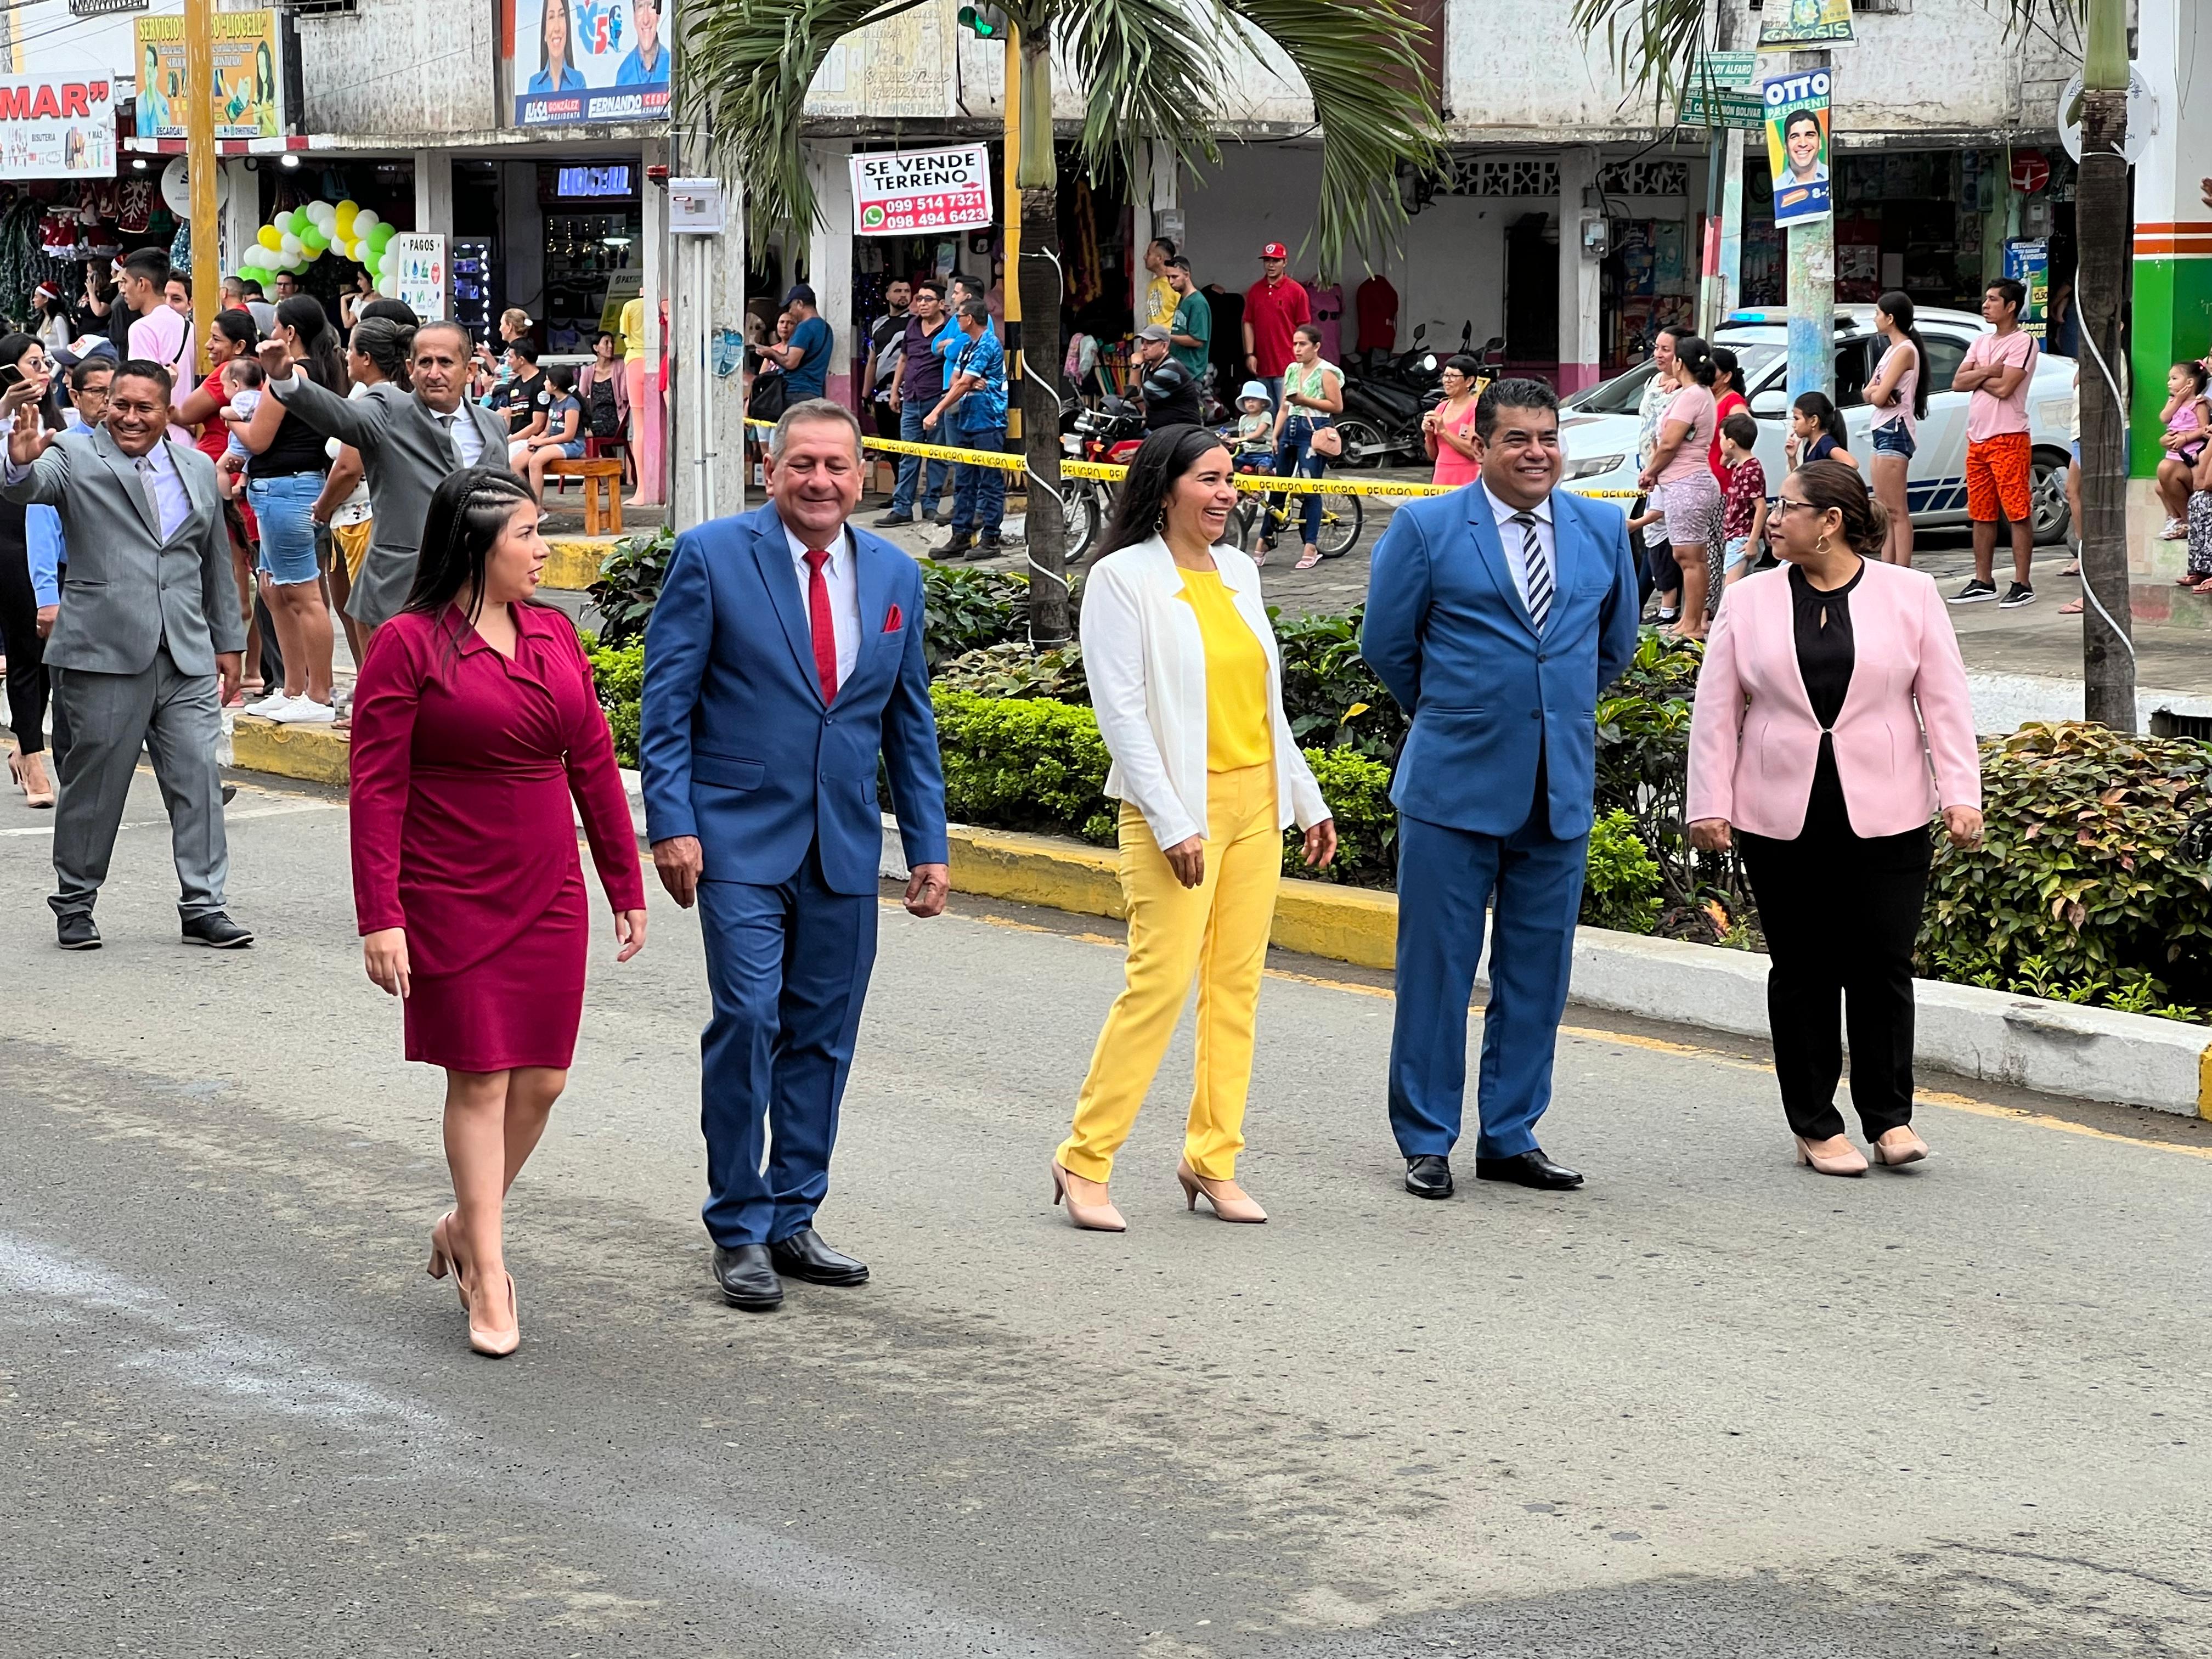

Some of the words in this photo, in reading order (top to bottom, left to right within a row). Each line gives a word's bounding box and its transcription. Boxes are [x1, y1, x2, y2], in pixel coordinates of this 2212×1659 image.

[139, 18, 179, 41] SERVICIO
[1766, 73, 1830, 105] OTTO
[588, 94, 642, 117] FERNANDO
[1694, 103, 1714, 114] CAE
[865, 161, 889, 176] SE
[898, 153, 975, 172] VENDE
[874, 170, 967, 190] TERRENO
[886, 199, 913, 213] 099
[917, 196, 944, 210] 514
[947, 193, 982, 206] 7321
[887, 215, 914, 229] 098
[918, 212, 945, 225] 494
[950, 208, 985, 222] 6423
[410, 240, 434, 251] PAGOS
[887, 442, 921, 456] PELIGRO
[928, 448, 964, 462] PELIGRO
[972, 454, 1008, 468] PELIGRO
[1062, 465, 1101, 478] PELIGRO
[1260, 481, 1304, 493] PELIGRO
[1312, 484, 1357, 495] PELIGRO
